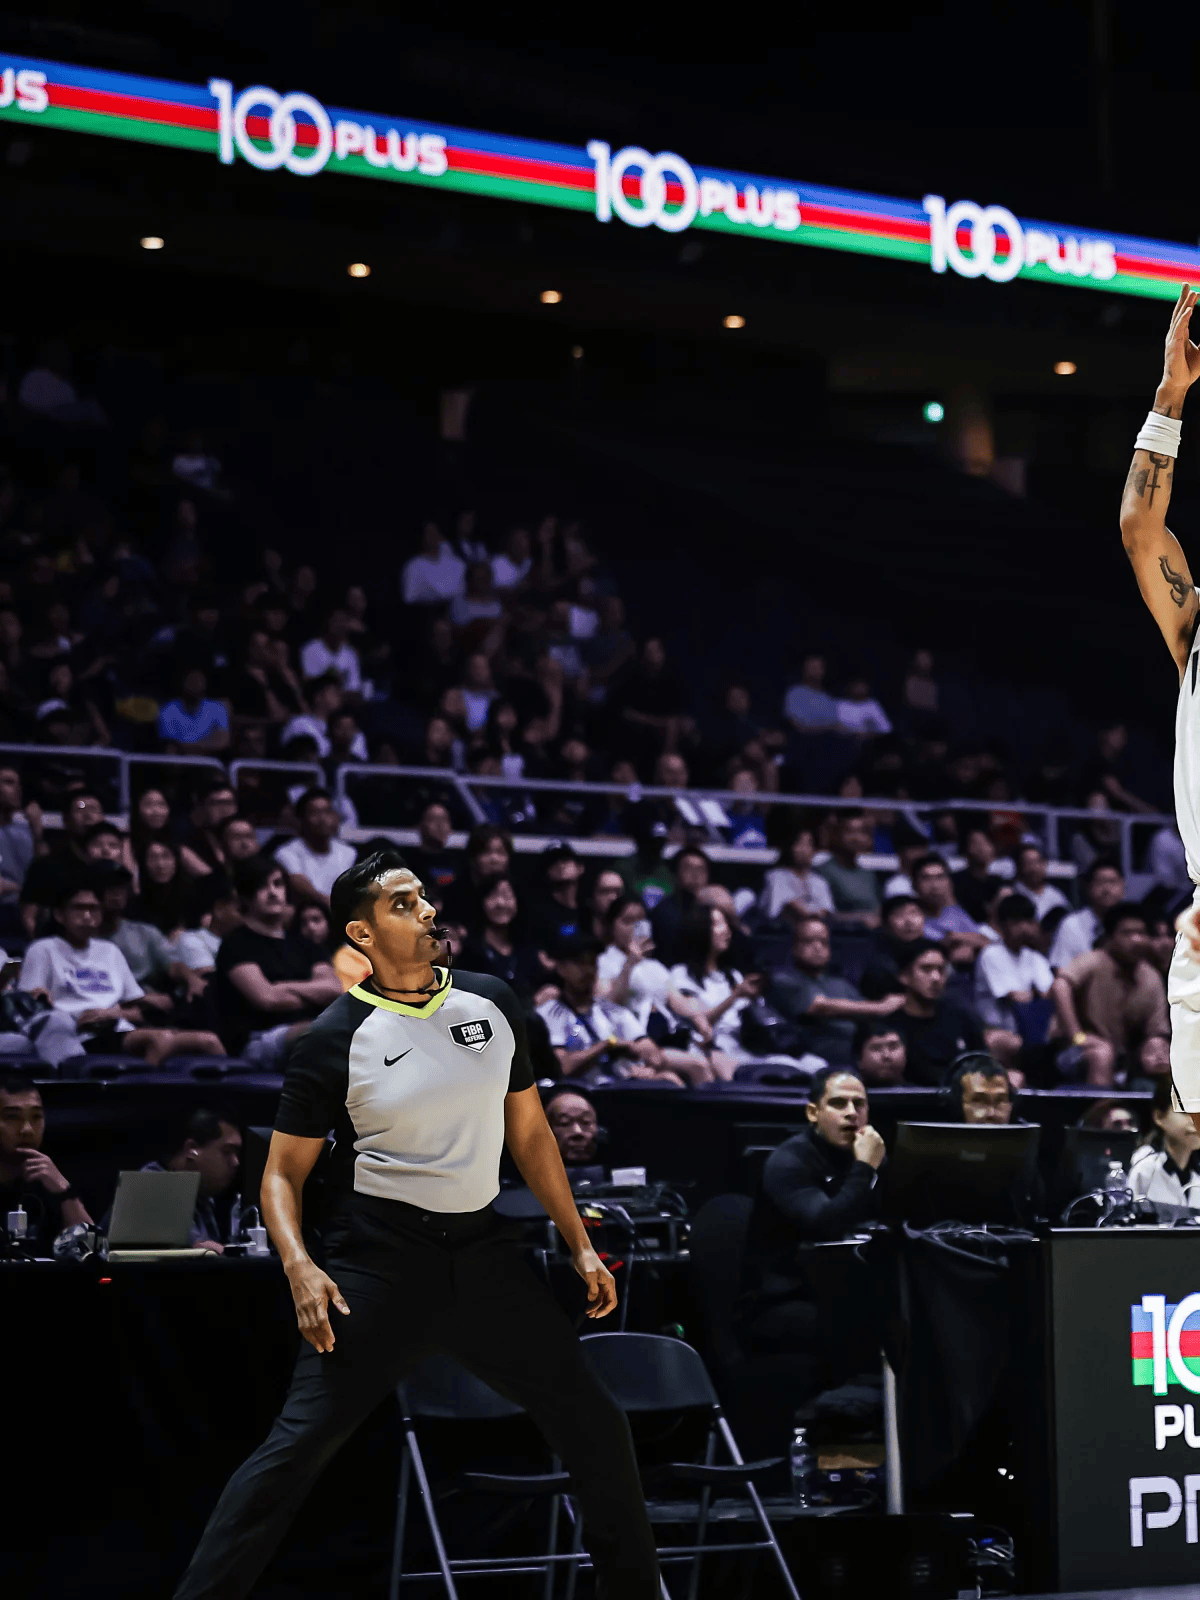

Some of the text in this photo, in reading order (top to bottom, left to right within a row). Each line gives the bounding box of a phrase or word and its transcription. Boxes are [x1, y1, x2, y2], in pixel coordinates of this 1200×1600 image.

[208, 78, 449, 176] 100 PLUS
[586, 139, 802, 233] 100 PLUS
[922, 194, 1118, 283] 100 PLUS
[461, 1023, 483, 1037] FIBA
